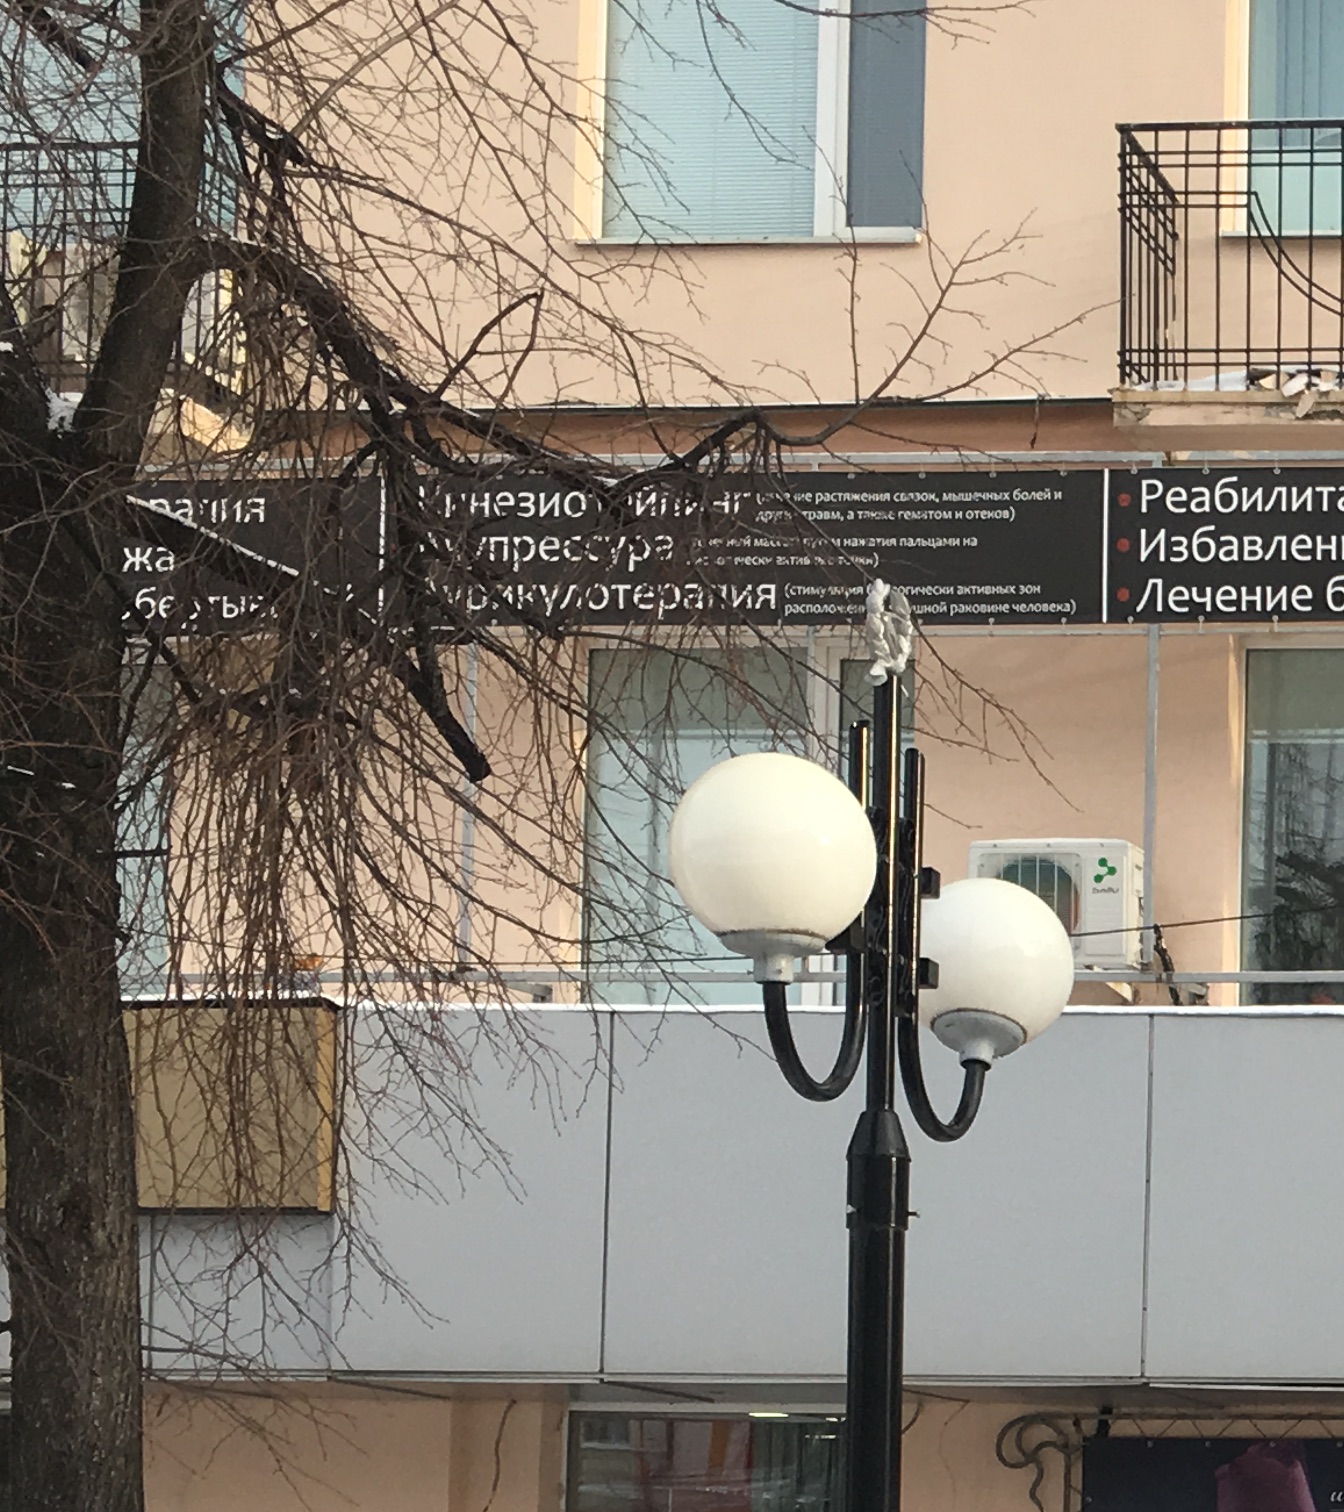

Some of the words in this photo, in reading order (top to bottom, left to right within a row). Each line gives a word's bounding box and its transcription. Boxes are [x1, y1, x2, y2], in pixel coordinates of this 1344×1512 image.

[815, 491, 890, 506] растяжения
[942, 490, 1010, 503] мышечных
[1013, 488, 1051, 501] болей
[1054, 491, 1062, 500] и
[802, 510, 844, 521] травм,
[847, 511, 854, 519] а
[955, 511, 963, 519] и
[965, 506, 1016, 522] отеков)
[899, 537, 960, 549] пальцами
[963, 537, 978, 547] на
[957, 585, 1016, 596] активных
[1019, 585, 1041, 595] зон
[1137, 580, 1313, 613] Лечение
[950, 602, 1010, 616] раковине
[1013, 599, 1077, 615] человека)
